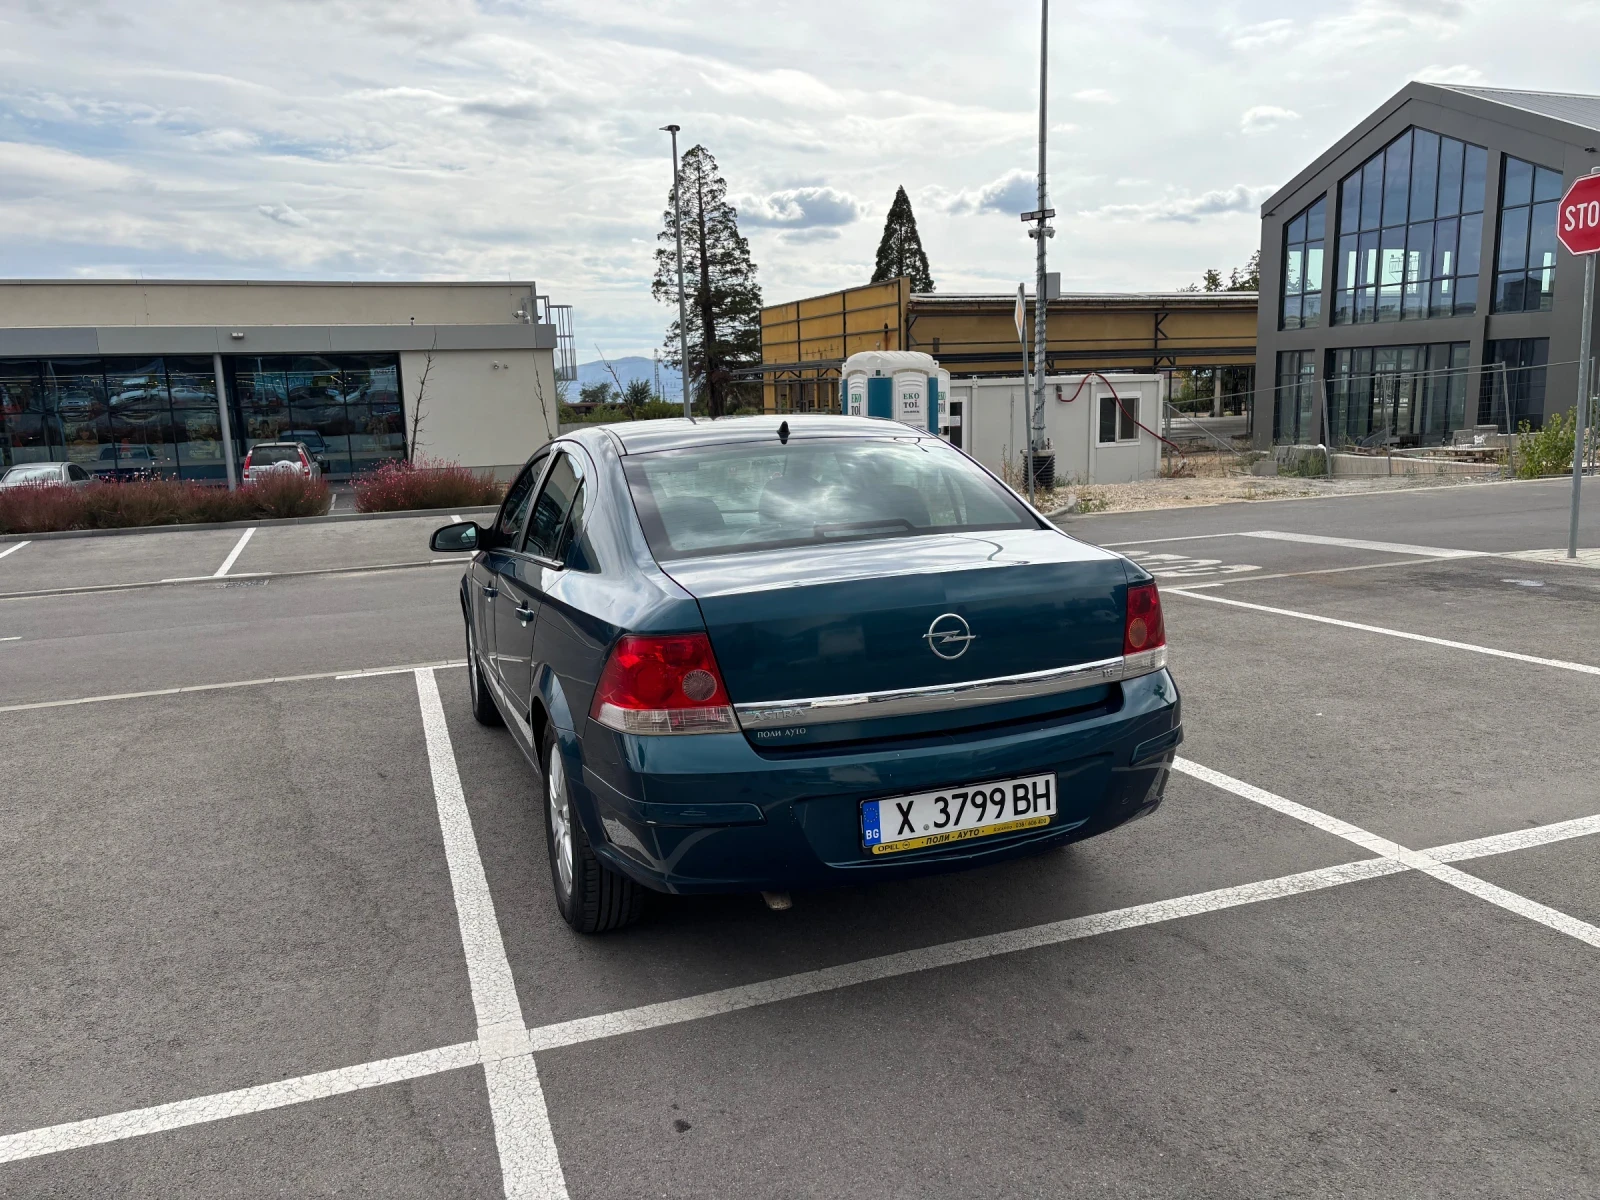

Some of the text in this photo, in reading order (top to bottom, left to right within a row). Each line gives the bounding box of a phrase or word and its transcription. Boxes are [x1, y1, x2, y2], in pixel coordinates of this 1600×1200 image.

[1565, 200, 1600, 231] STO
[903, 392, 920, 400] EKO
[752, 707, 805, 721] ASTRA
[757, 727, 807, 739] ПОЛИ АУТО
[933, 787, 1006, 829] 3799
[865, 828, 880, 840] BG
[877, 843, 900, 852] OPEL
[926, 833, 951, 845] ПОЛИ
[956, 828, 980, 840] АУТО
